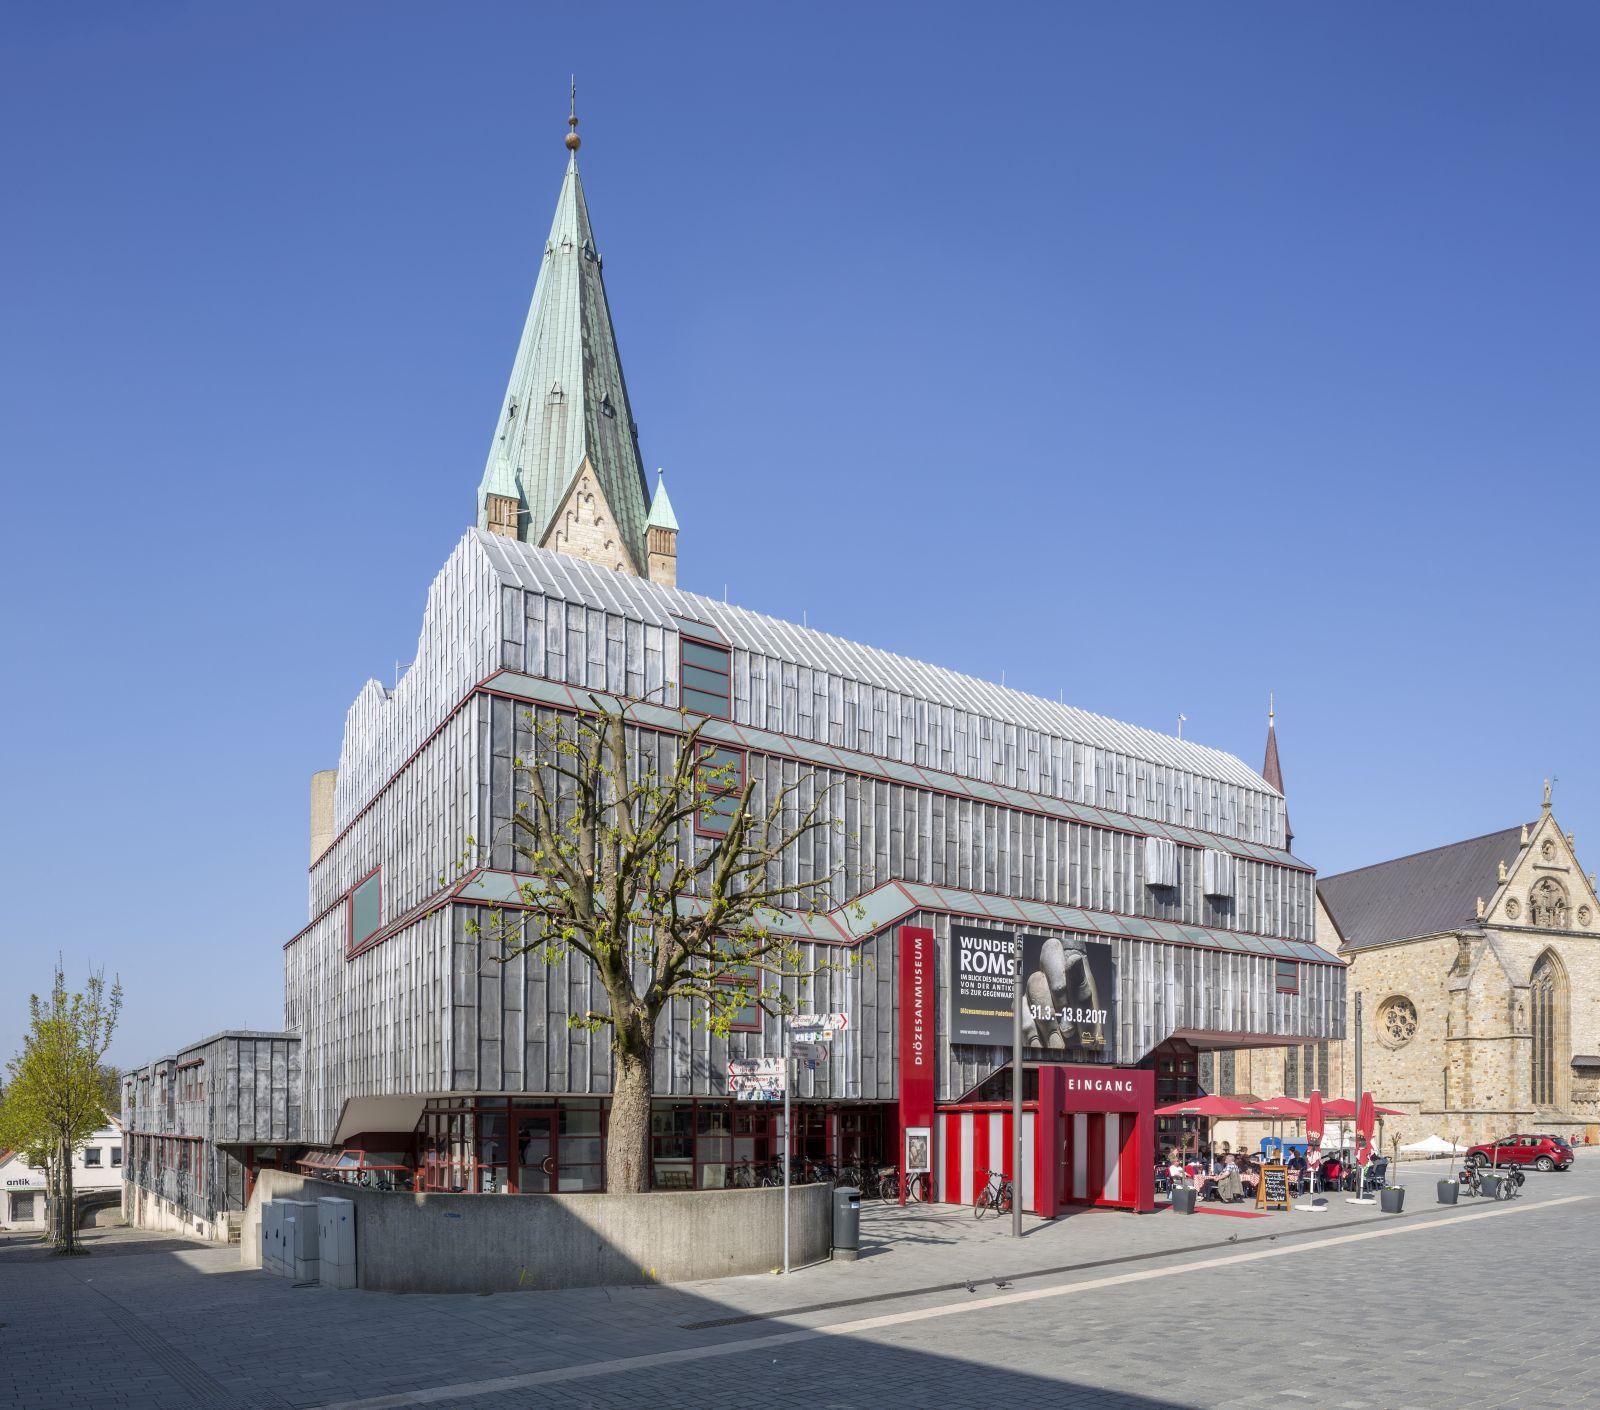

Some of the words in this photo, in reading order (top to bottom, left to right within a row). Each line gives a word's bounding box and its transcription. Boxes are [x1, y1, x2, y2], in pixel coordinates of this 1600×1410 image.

[960, 936, 1015, 953] WUNDER
[968, 974, 982, 982] BLICK
[977, 982, 990, 990] DER
[913, 938, 922, 1065] DIÖZESANMUSEUM
[1068, 1079, 1132, 1092] EINGANG
